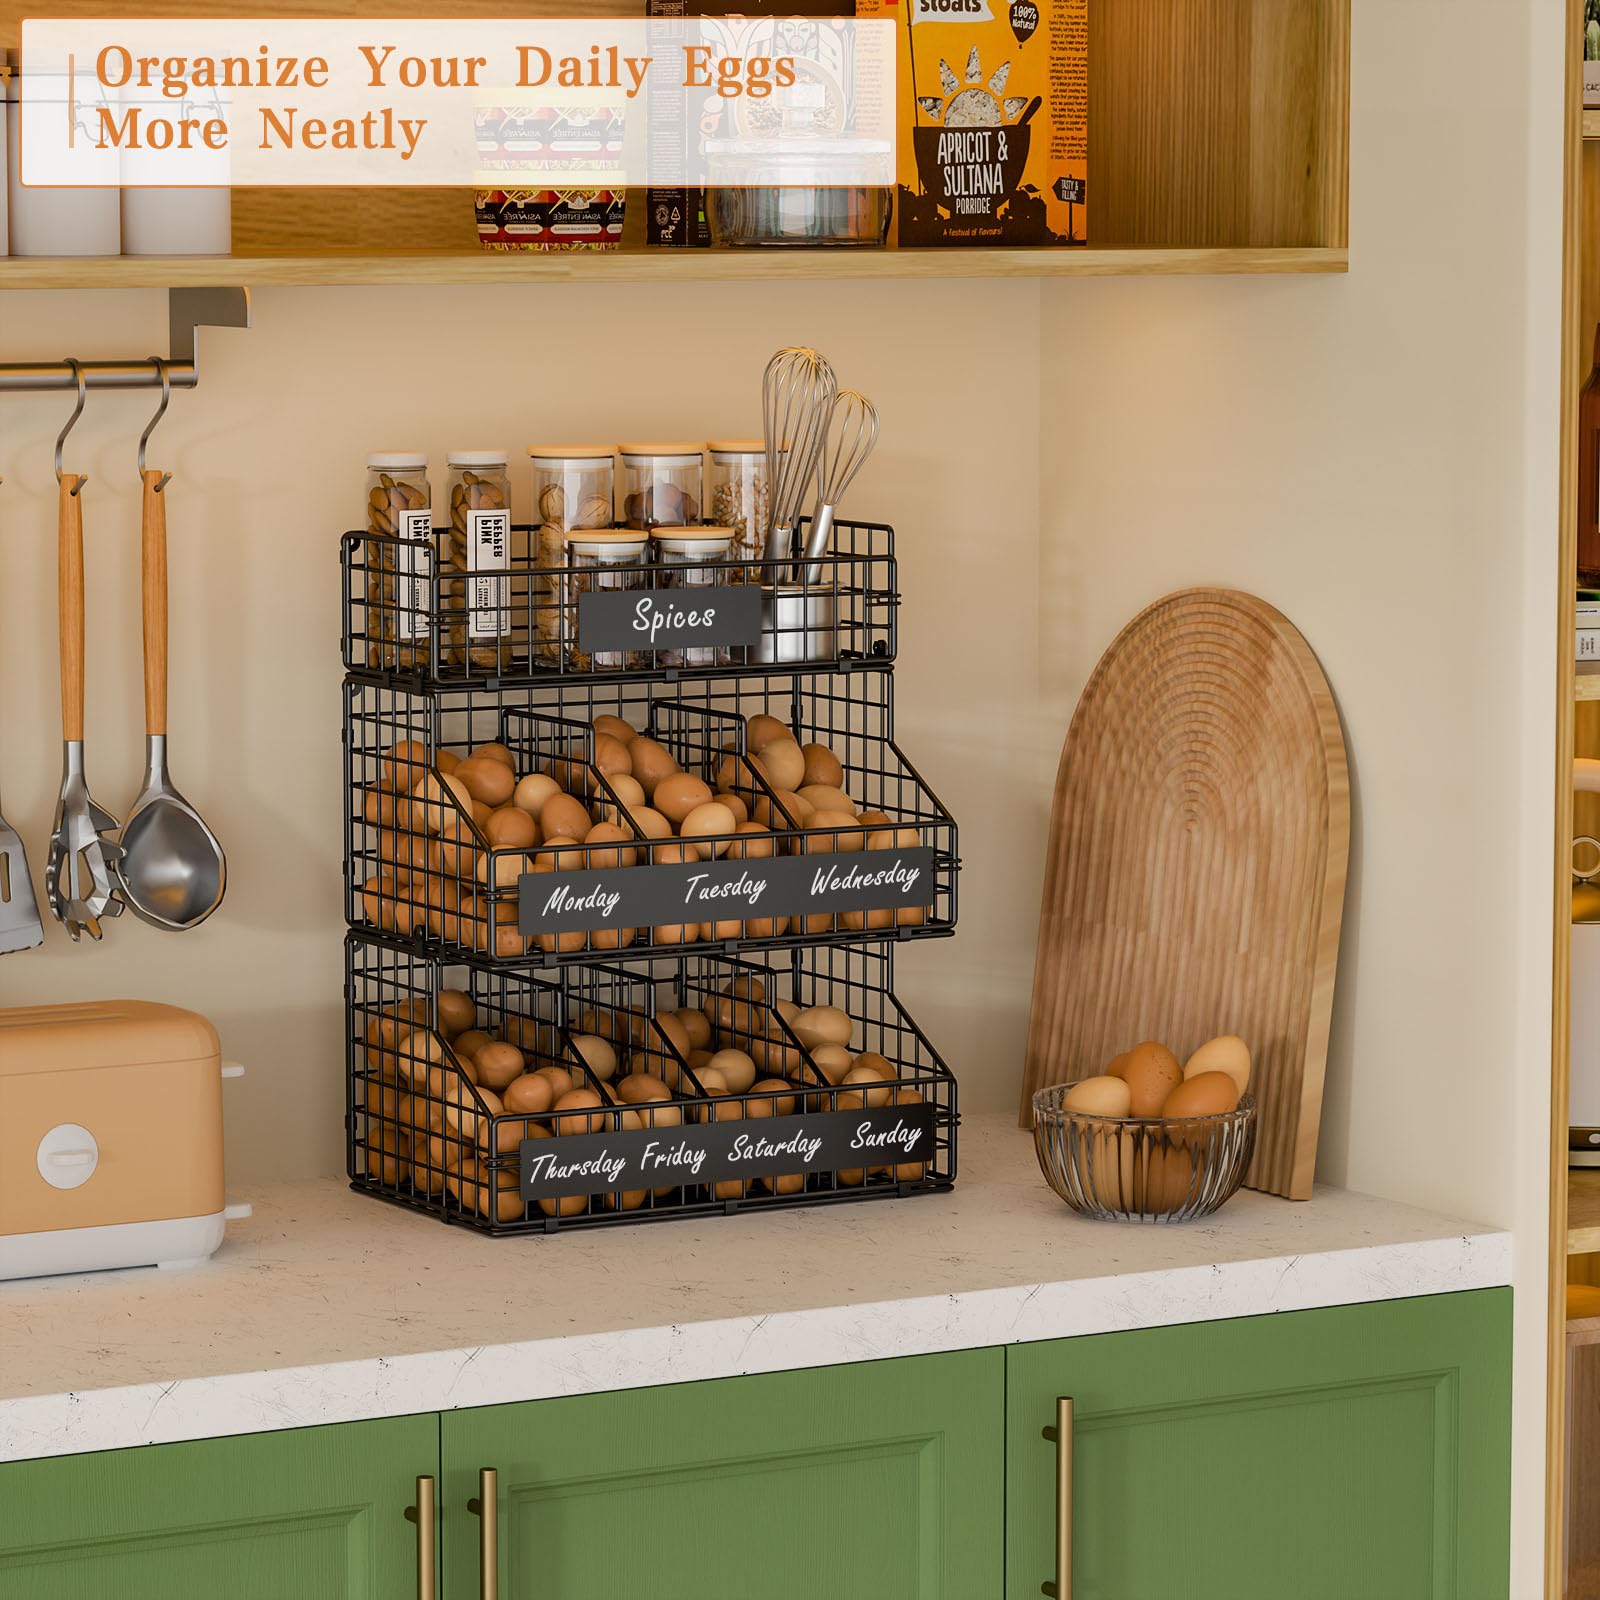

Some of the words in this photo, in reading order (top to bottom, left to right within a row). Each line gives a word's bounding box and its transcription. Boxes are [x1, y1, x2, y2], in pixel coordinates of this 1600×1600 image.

[1012, 5, 1037, 20] 100%
[1012, 18, 1036, 30] Natural
[937, 131, 992, 165] APRICOT
[997, 130, 1009, 162] &
[943, 163, 1004, 197] SULTANA
[955, 197, 991, 215] PORRIDGE
[632, 597, 716, 644] Spices
[542, 884, 621, 917] Monday
[685, 871, 767, 905] Tuesday
[810, 859, 920, 897] Wednesday
[530, 1150, 626, 1184] Thursday
[640, 1140, 707, 1174] Friday
[727, 1129, 822, 1163] Saturday
[850, 1119, 922, 1153] Sunday
